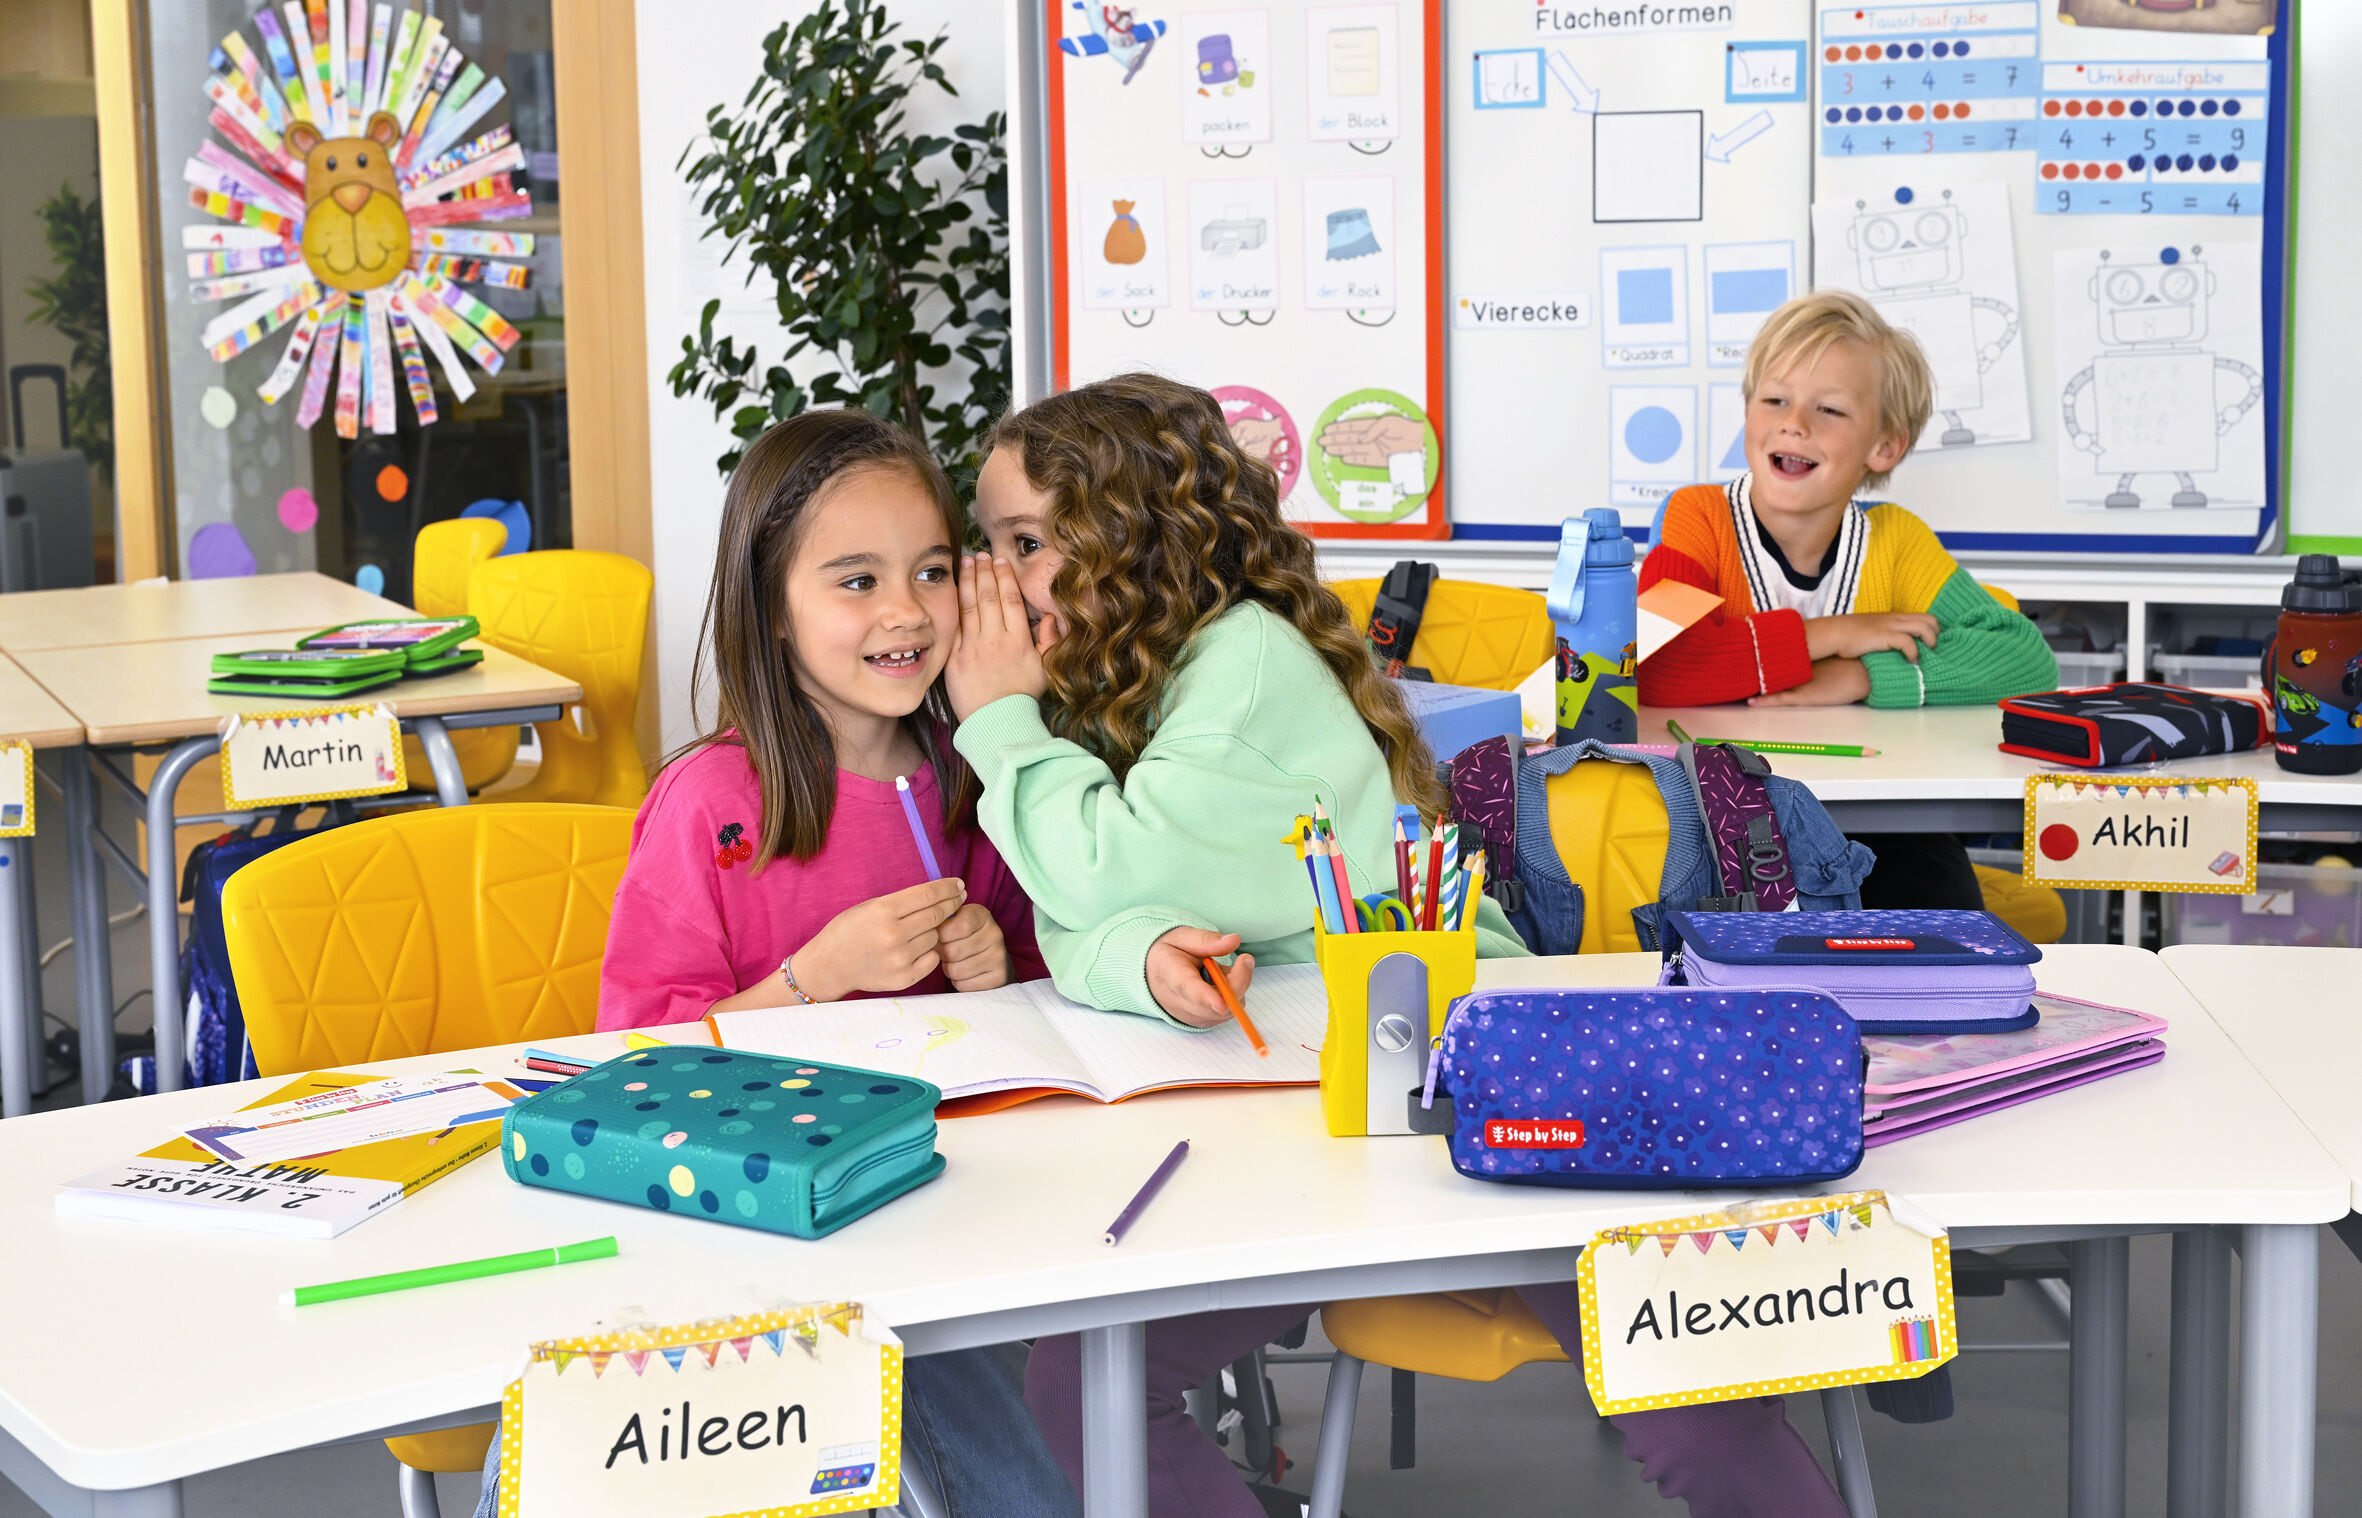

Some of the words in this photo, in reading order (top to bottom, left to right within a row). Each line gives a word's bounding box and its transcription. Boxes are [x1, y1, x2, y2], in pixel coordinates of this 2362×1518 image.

[1842, 72, 1853, 94] 3
[1921, 69, 1935, 91] 4
[2005, 65, 2018, 88] 7
[2087, 66, 2224, 90] Umkehraufgabe
[1202, 120, 1250, 133] packen
[1347, 114, 1388, 129] Block
[1841, 133, 1855, 155] 4
[1922, 131, 1934, 153] 3
[2005, 127, 2018, 150] 7
[2059, 127, 2074, 150] 4
[2143, 127, 2156, 151] 5
[2231, 127, 2245, 151] 9
[2057, 190, 2071, 213] 9
[2141, 191, 2153, 214] 5
[2226, 191, 2241, 213] 4
[1124, 284, 1155, 297] Sack
[1223, 284, 1273, 299] Drucker
[1347, 284, 1382, 297] Rock
[1471, 300, 1578, 322] Vierecke
[1620, 348, 1674, 361] Quadrat
[263, 740, 363, 770] Martin
[2092, 815, 2189, 848] Akhil
[1507, 1127, 1532, 1143] Step
[1534, 1127, 1549, 1143] by
[1551, 1127, 1577, 1143] Step
[111, 1174, 269, 1203] KLASSE
[1626, 1268, 1914, 1345] Alexandra
[605, 1401, 807, 1469] Aileen
